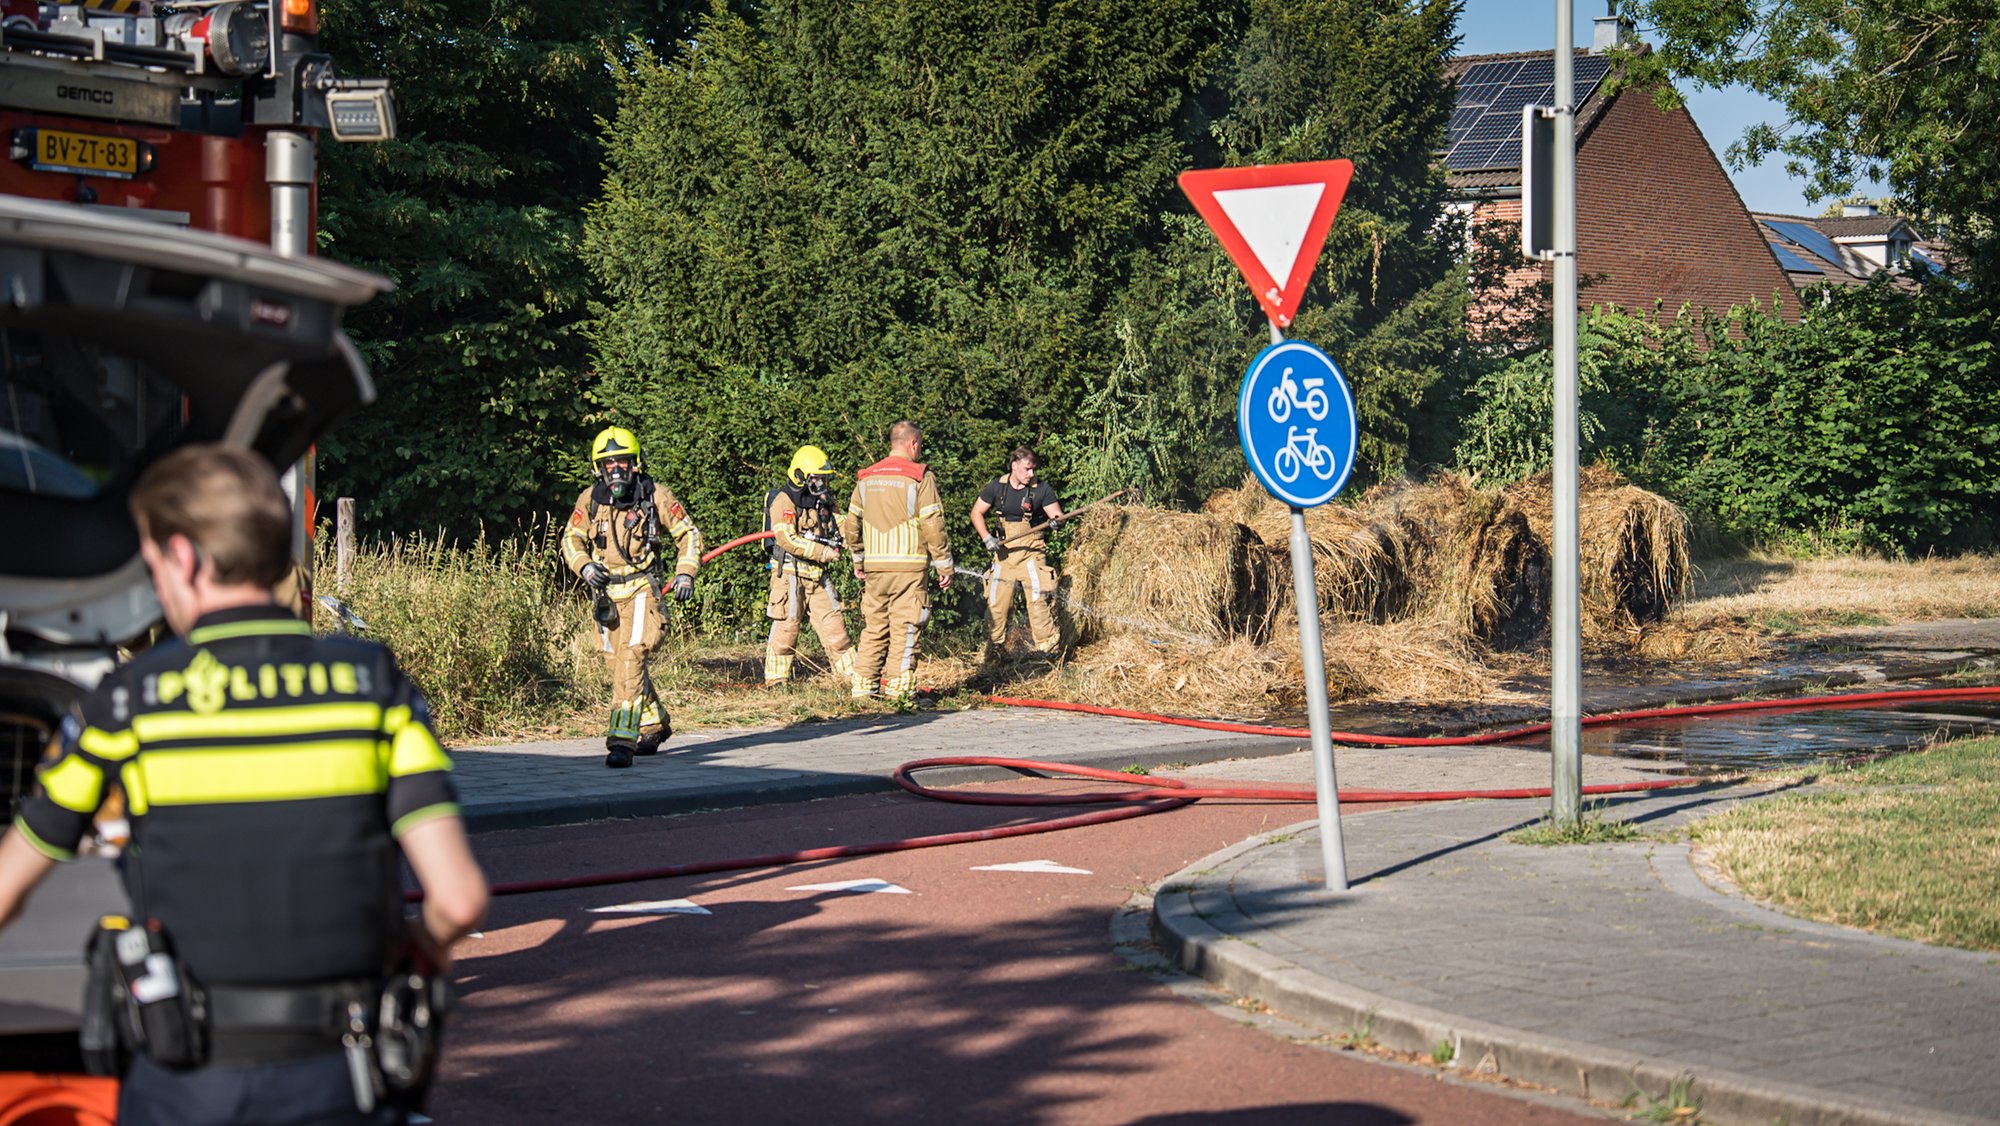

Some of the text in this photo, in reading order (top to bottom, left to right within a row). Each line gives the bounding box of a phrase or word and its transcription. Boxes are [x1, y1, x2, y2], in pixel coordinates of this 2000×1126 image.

[57, 85, 114, 104] GEMCO
[46, 135, 128, 167] BV-ZT-83
[157, 651, 358, 713] POLITIE
